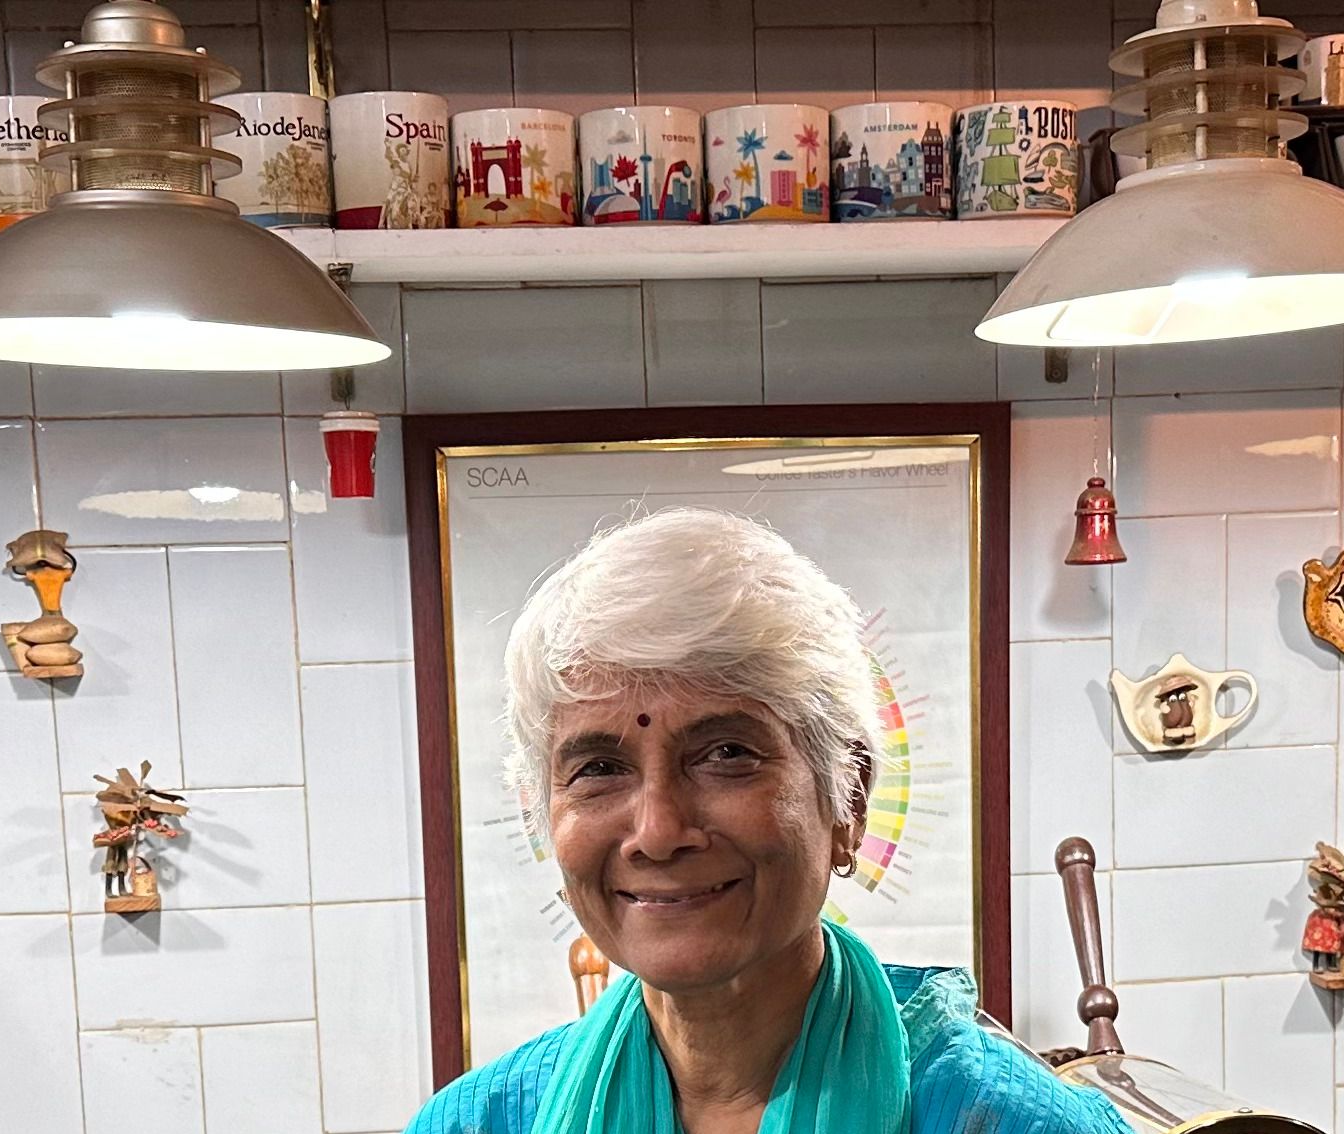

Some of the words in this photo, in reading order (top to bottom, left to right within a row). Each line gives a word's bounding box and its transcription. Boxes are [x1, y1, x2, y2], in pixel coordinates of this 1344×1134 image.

[385, 113, 447, 145] Spain
[863, 123, 919, 133] AMSTERDAM
[661, 134, 696, 145] TORONTO
[466, 466, 530, 489] SCAA
[805, 468, 856, 480] Tasters
[906, 462, 949, 476] Wheel
